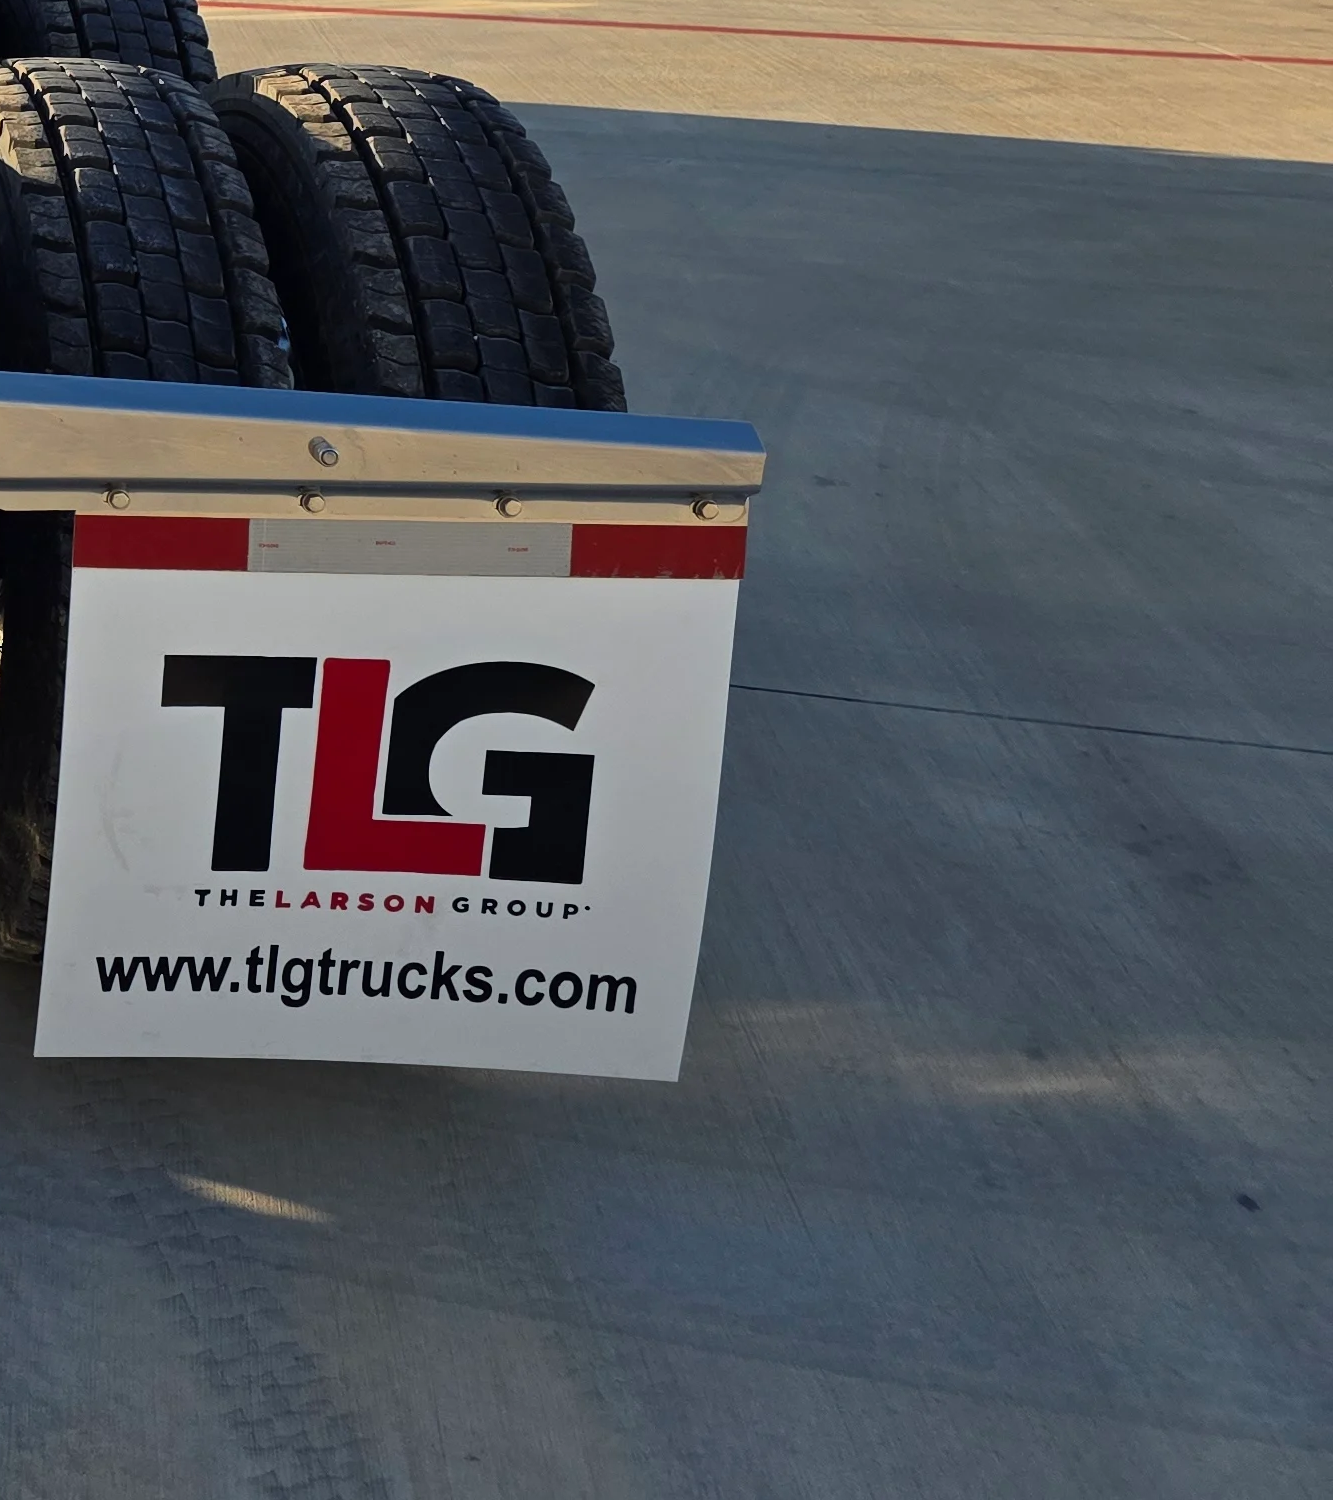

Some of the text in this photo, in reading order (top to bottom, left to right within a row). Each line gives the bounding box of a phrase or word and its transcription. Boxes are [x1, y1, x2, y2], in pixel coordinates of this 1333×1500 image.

[160, 654, 597, 885] TLG
[451, 896, 580, 920] GROUP
[95, 944, 639, 1015] www.tlgtrucks.com
